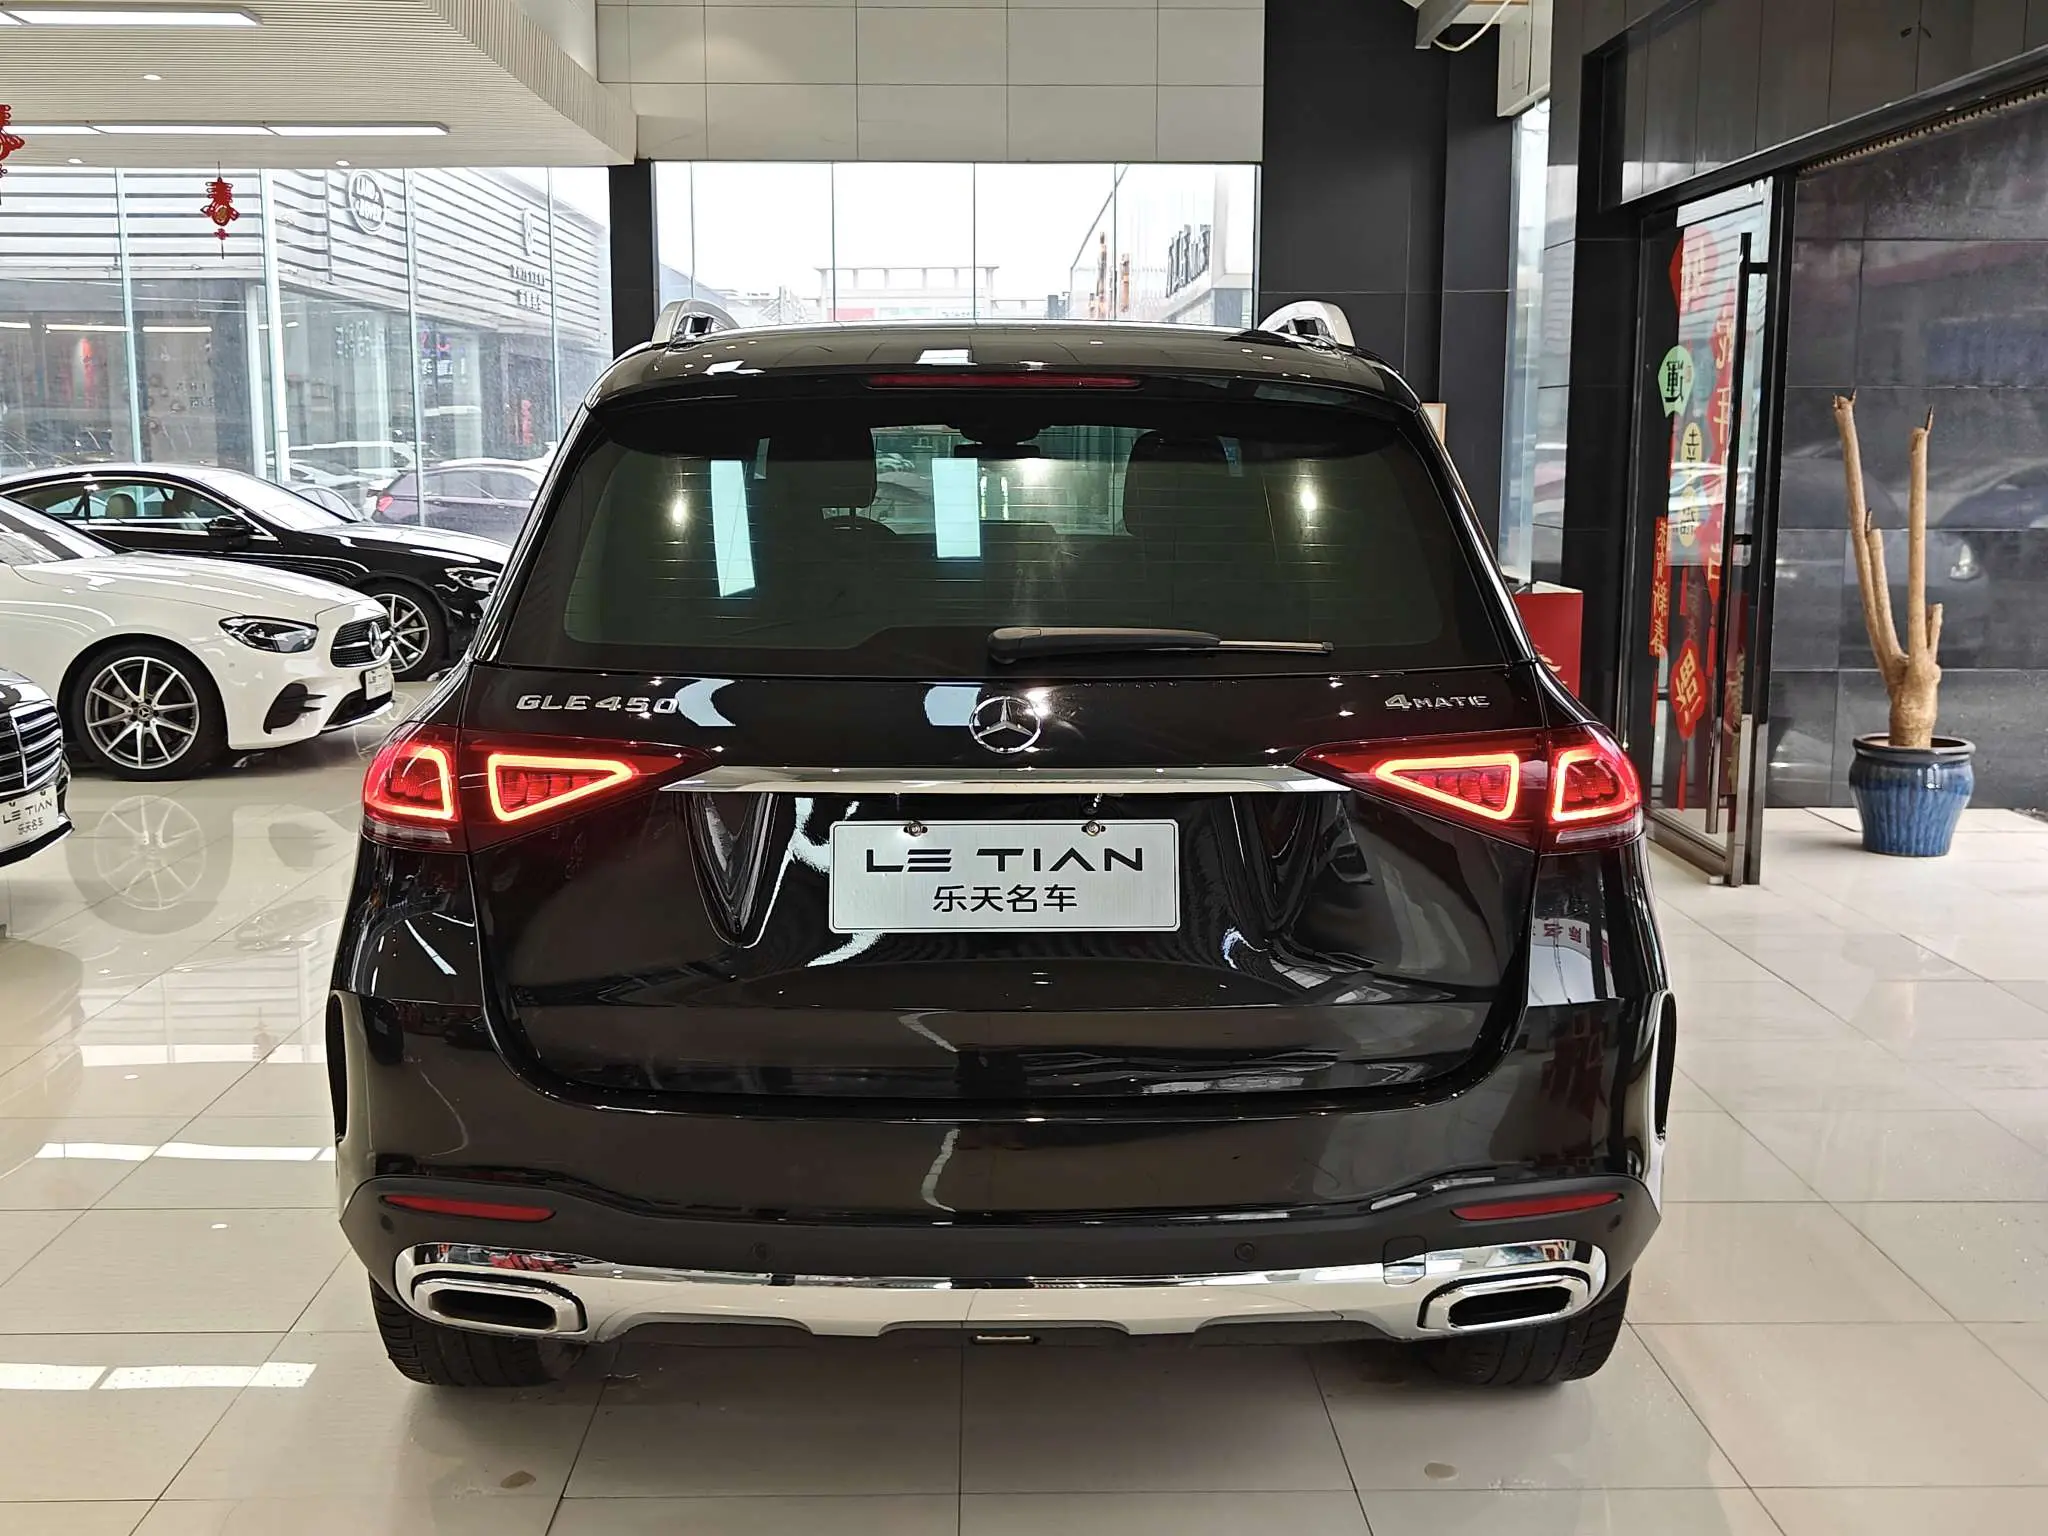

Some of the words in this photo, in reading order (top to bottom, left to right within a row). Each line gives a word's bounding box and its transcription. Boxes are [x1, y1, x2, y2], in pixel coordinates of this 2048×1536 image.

[1385, 694, 1491, 708] 4MATIC
[866, 848, 952, 872] LE
[976, 848, 1143, 872] TIAN
[933, 884, 1077, 912] 乐天名车
